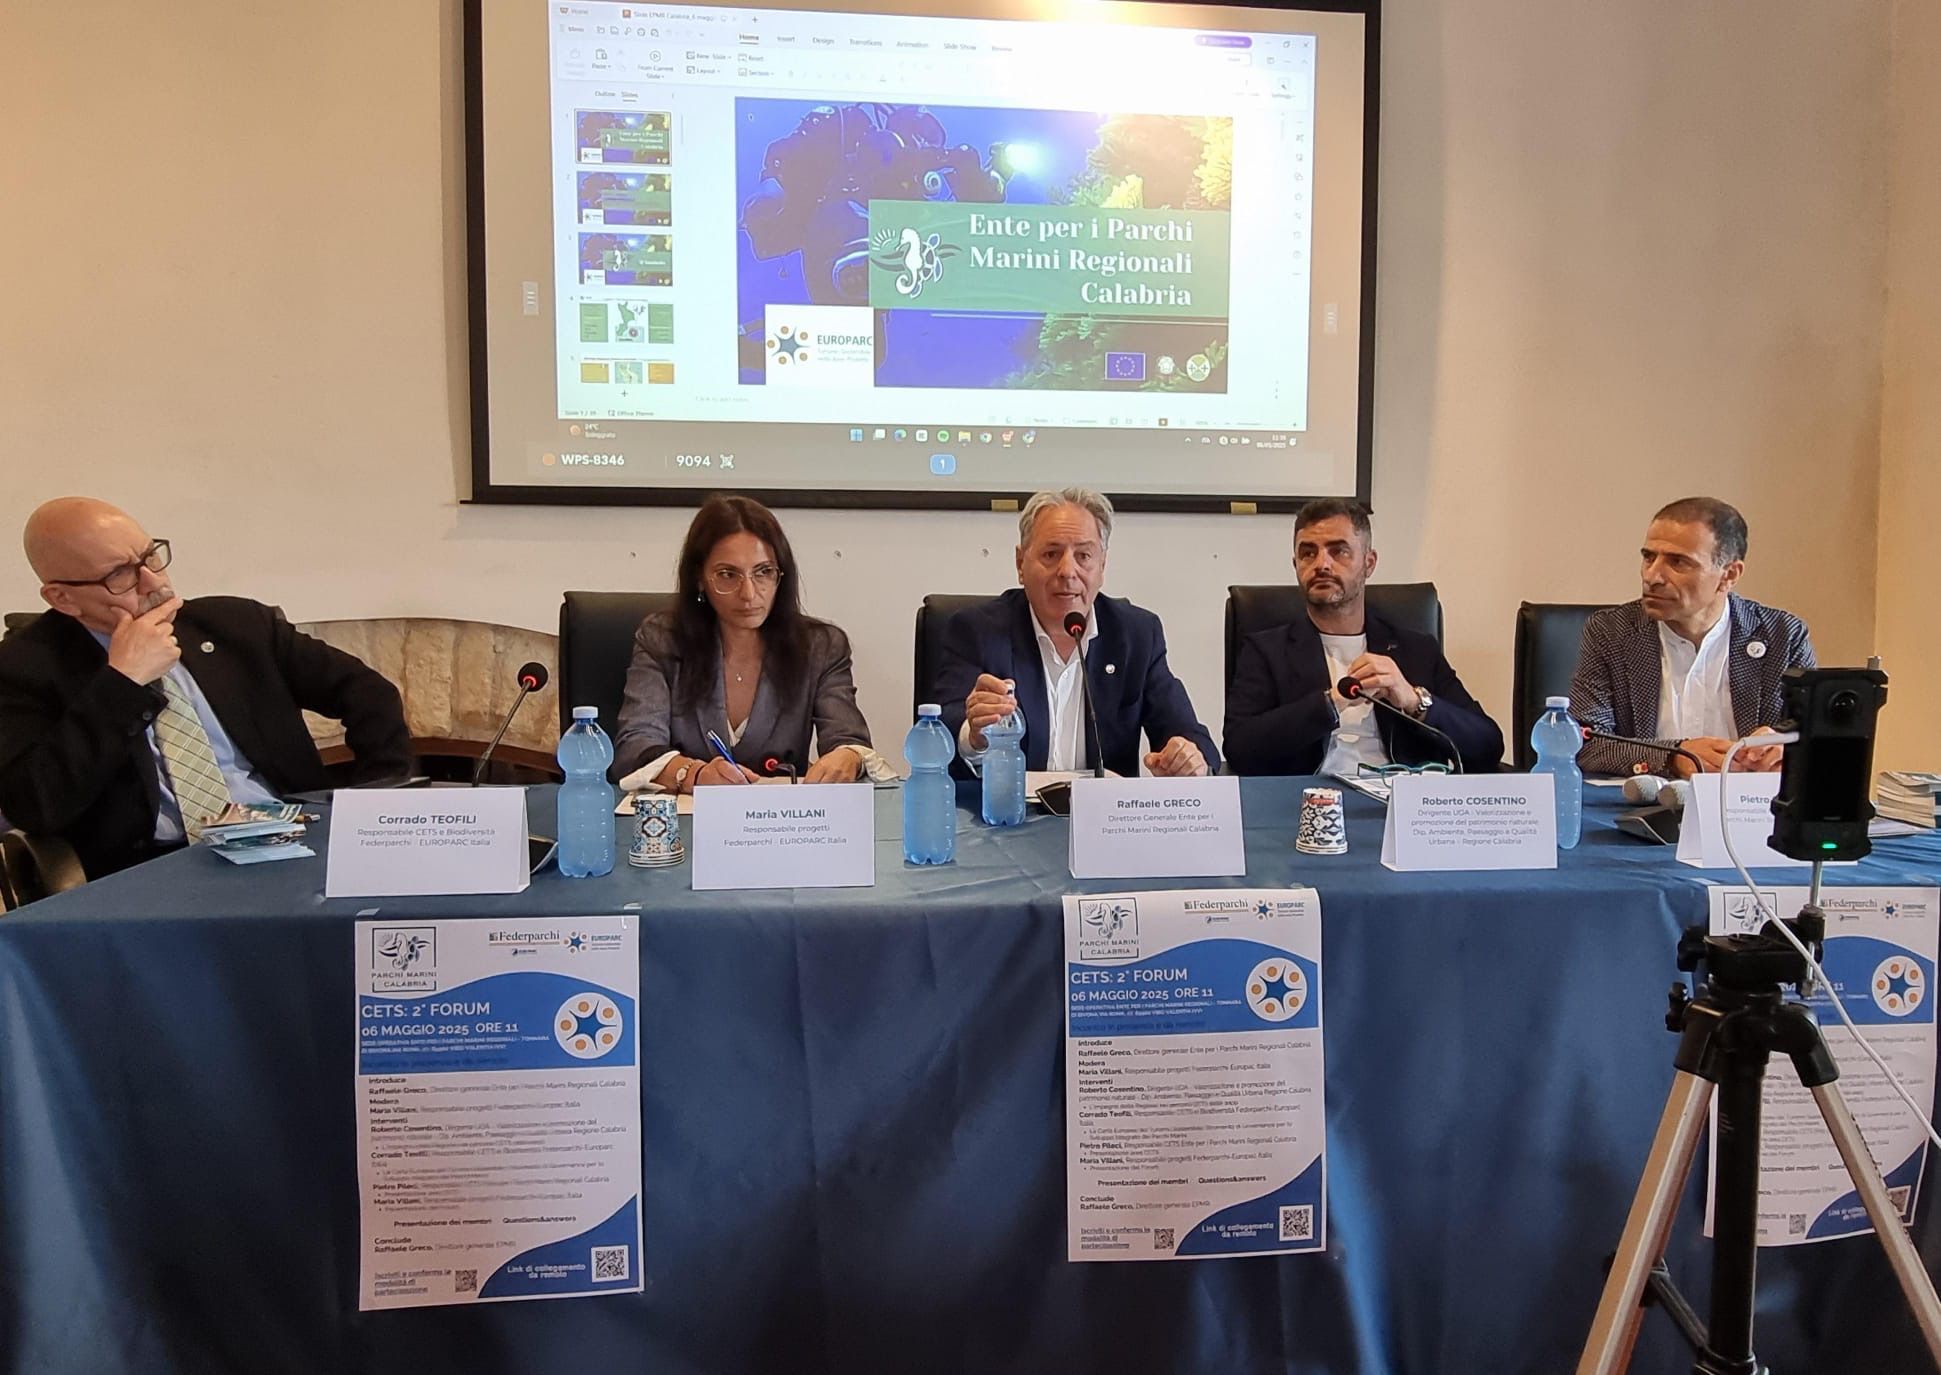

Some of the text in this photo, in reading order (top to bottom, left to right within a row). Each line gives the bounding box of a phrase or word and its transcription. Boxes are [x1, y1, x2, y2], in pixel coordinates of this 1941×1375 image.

[812, 37, 834, 46] Design
[850, 38, 882, 46] Transitions
[969, 214, 1193, 242] Ente per i Parchi
[969, 246, 1192, 275] Marini Regionali
[1081, 281, 1192, 306] Calabria
[817, 335, 872, 346] EUROPARC
[561, 454, 711, 467] WPS-8346 9094
[941, 459, 945, 469] 1
[1117, 799, 1201, 809] Raffaele GRECO
[1422, 797, 1526, 806] Roberto COSENTINO
[1740, 796, 1770, 804] Pietro
[746, 809, 825, 819] Maria VILLANI
[1197, 814, 1210, 822] per
[1418, 809, 1451, 818] Dirigente
[379, 815, 476, 824] Corrado TEOFILI
[358, 829, 413, 837] Responsabile
[447, 828, 495, 836] Biodiversità
[743, 824, 830, 834] Responsabile progetti
[1153, 826, 1187, 834] Regionali
[360, 839, 411, 847] Federparchi
[420, 838, 469, 846] EUROPARC
[724, 838, 772, 847] Federparchi
[780, 837, 826, 846] EUROPARC
[1463, 838, 1491, 846] Regione
[1194, 899, 1248, 911] Federparchi
[1829, 899, 1877, 909] Federparchi
[500, 930, 560, 942] Federparchi
[1071, 971, 1113, 984] CETS:
[1134, 969, 1188, 981] FORUM
[384, 980, 427, 988] CALABRIA
[1833, 982, 1843, 991] 11
[1071, 993, 1085, 1002] 06
[1088, 990, 1138, 1001] MAGGIO
[1141, 991, 1169, 1000] 2025
[1175, 989, 1200, 998] ORE
[361, 1004, 407, 1018] CETS:
[431, 1002, 490, 1016] FORUM
[361, 1022, 519, 1036] 06 MAGGIO 2025 ORE 11
[1198, 1175, 1266, 1184] Questions&answers
[1228, 1223, 1274, 1231] collegamento
[535, 1264, 586, 1272] collegamento
